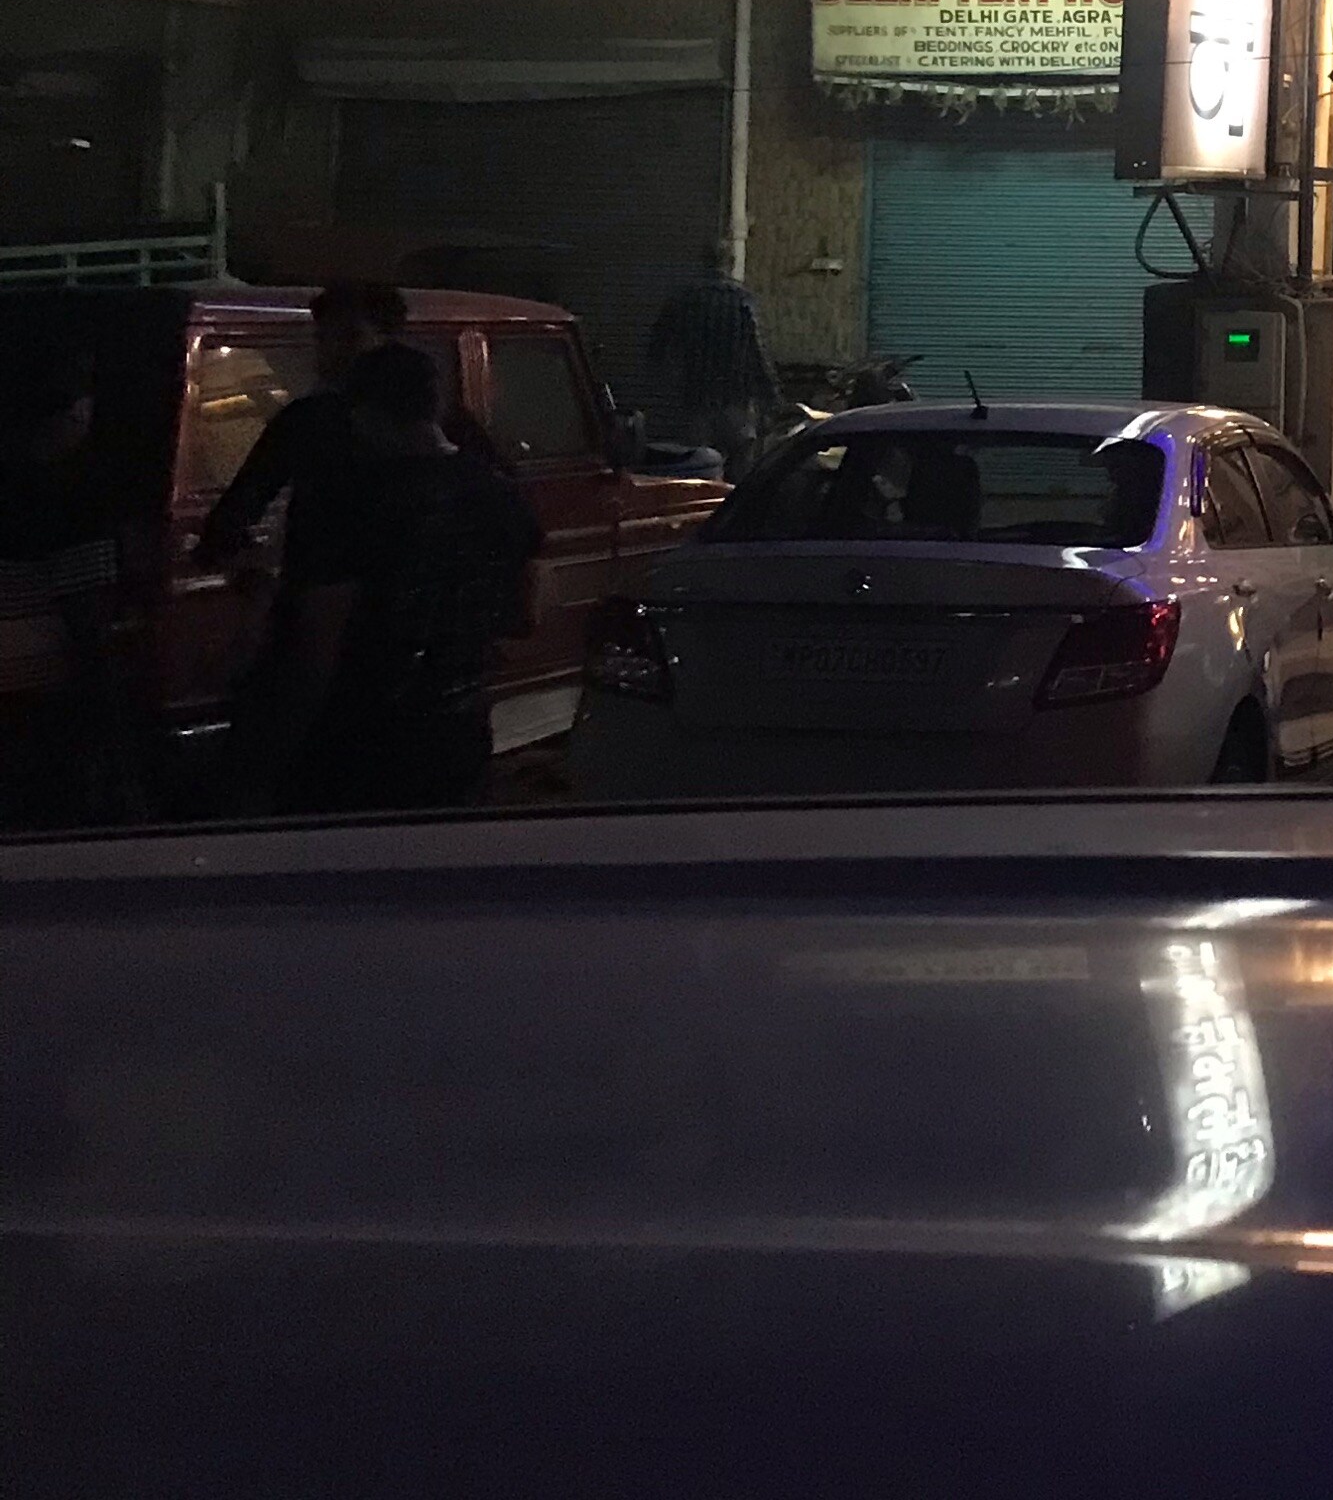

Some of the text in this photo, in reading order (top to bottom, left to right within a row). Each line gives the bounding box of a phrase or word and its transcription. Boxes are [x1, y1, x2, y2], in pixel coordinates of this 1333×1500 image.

[939, 9, 999, 24] DELHI
[974, 26, 1024, 38] FANCY
[1030, 26, 1092, 38] MEHFIL
[1000, 40, 1069, 53] CROCKRY
[1100, 41, 1119, 52] ON
[917, 55, 995, 68] CATERING
[1000, 55, 1036, 68] WITH
[1040, 55, 1123, 68] DELICIOUS
